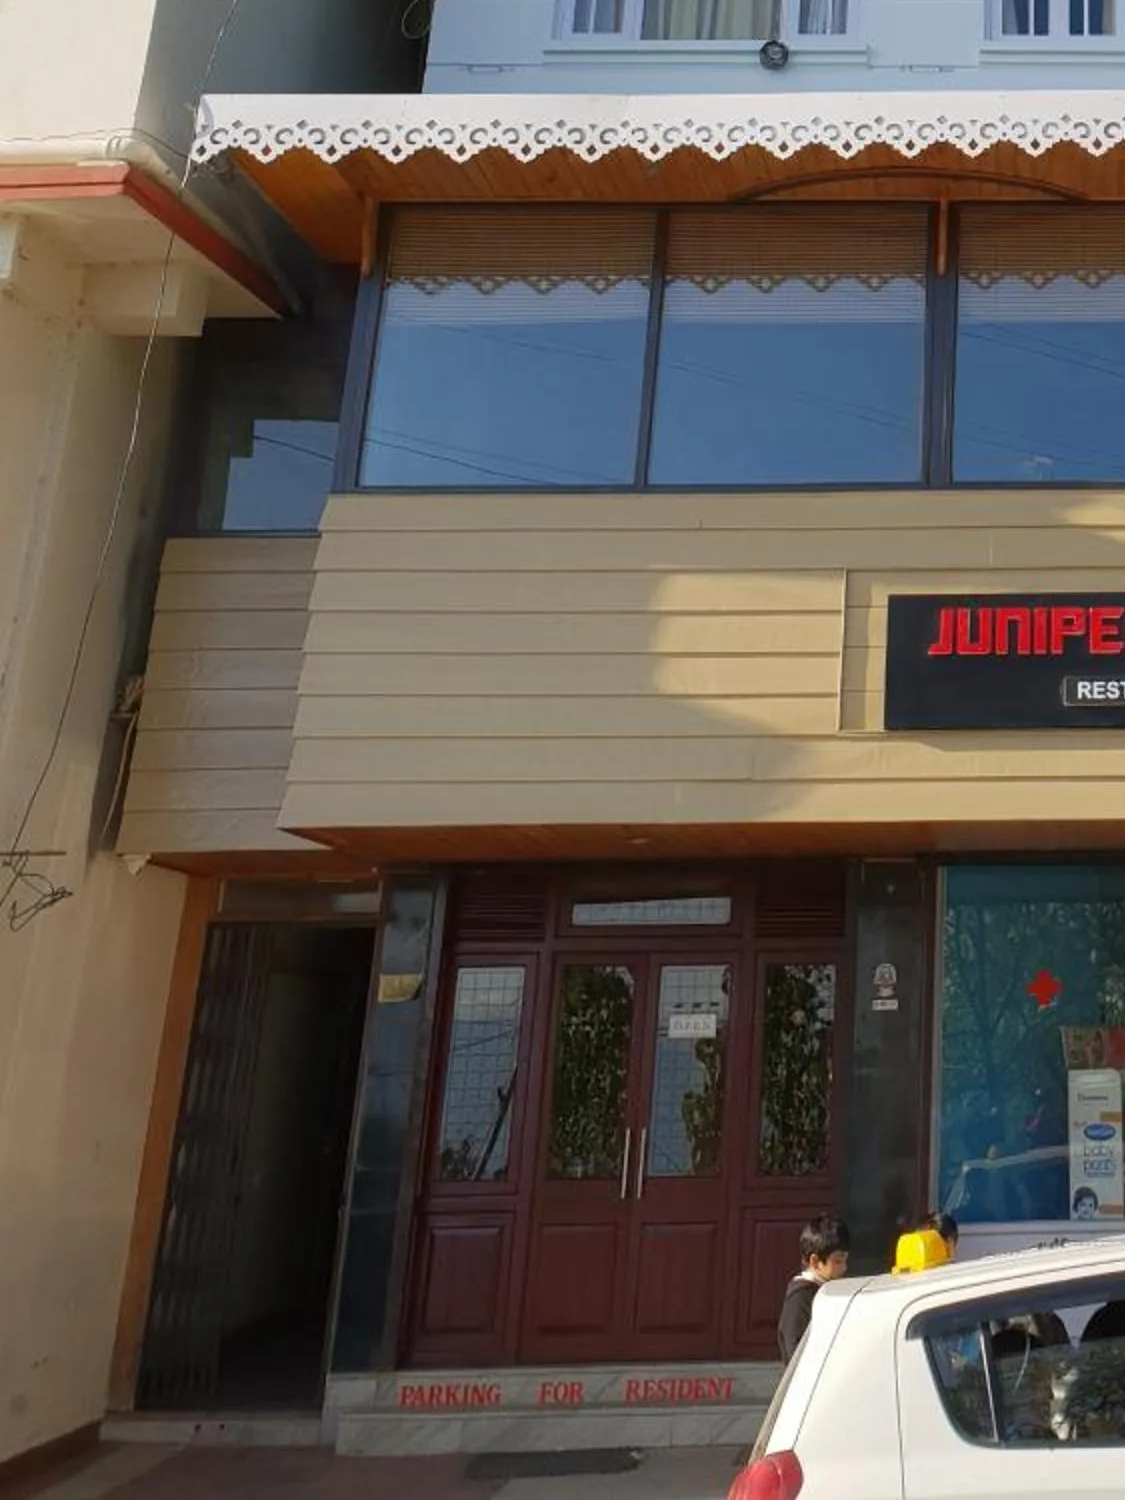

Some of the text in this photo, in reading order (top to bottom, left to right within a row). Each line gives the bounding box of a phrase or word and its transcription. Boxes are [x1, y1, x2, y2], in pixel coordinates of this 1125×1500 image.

[401, 1377, 737, 1407] PARKING FOR RESIDENT
